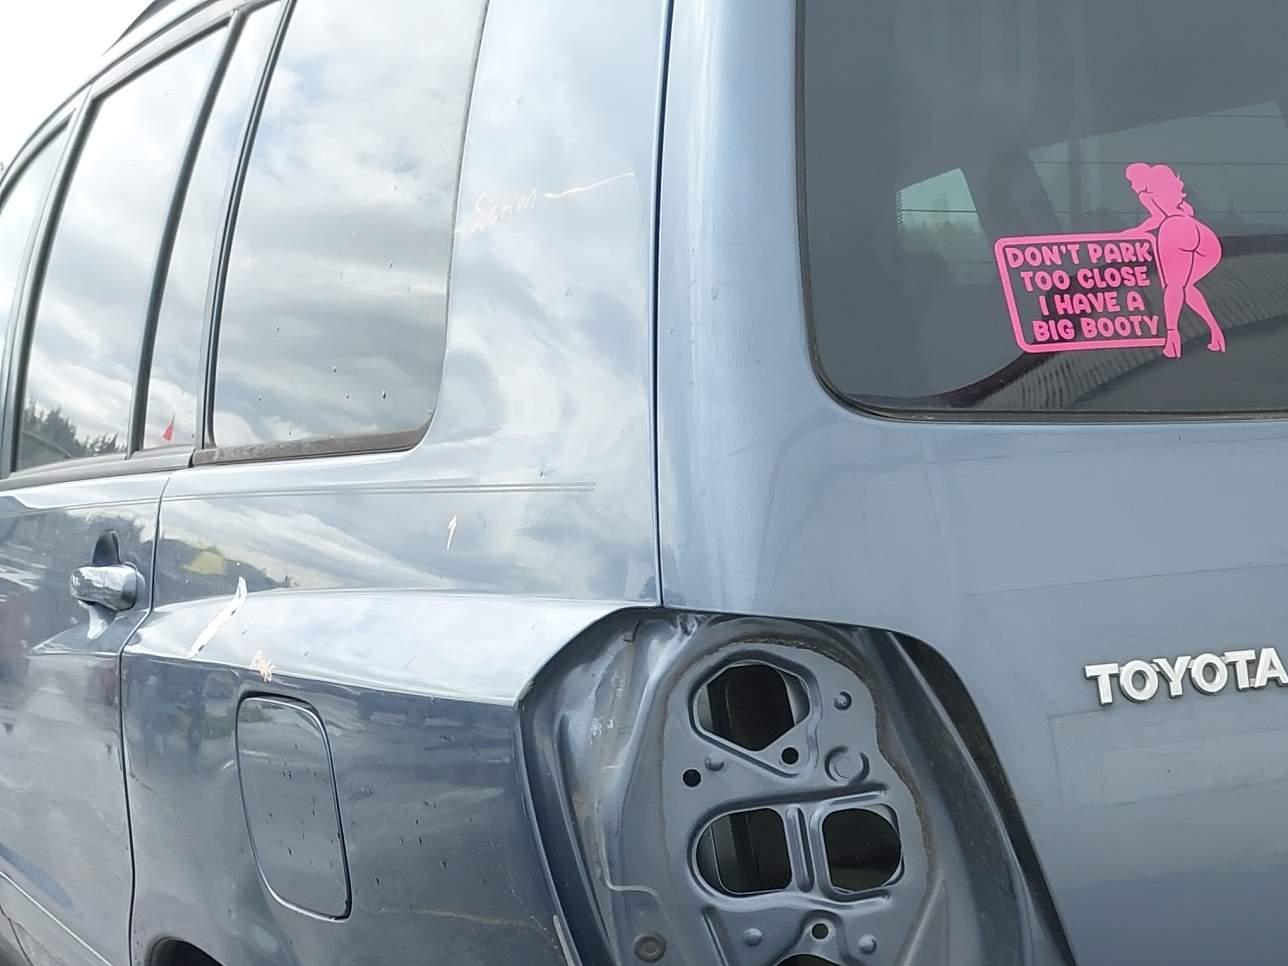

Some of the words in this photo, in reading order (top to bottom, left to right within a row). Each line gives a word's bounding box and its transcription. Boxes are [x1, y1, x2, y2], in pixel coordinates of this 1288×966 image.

[1004, 243, 1081, 269] DON'T
[1087, 242, 1153, 264] PARK
[1019, 270, 1071, 292] TOO
[1076, 266, 1150, 289] CLOSE
[1038, 295, 1050, 316] I
[1054, 291, 1121, 315] HAVE
[1126, 290, 1146, 311] A
[1031, 319, 1076, 342] BIG
[1080, 315, 1160, 339] BOOTY
